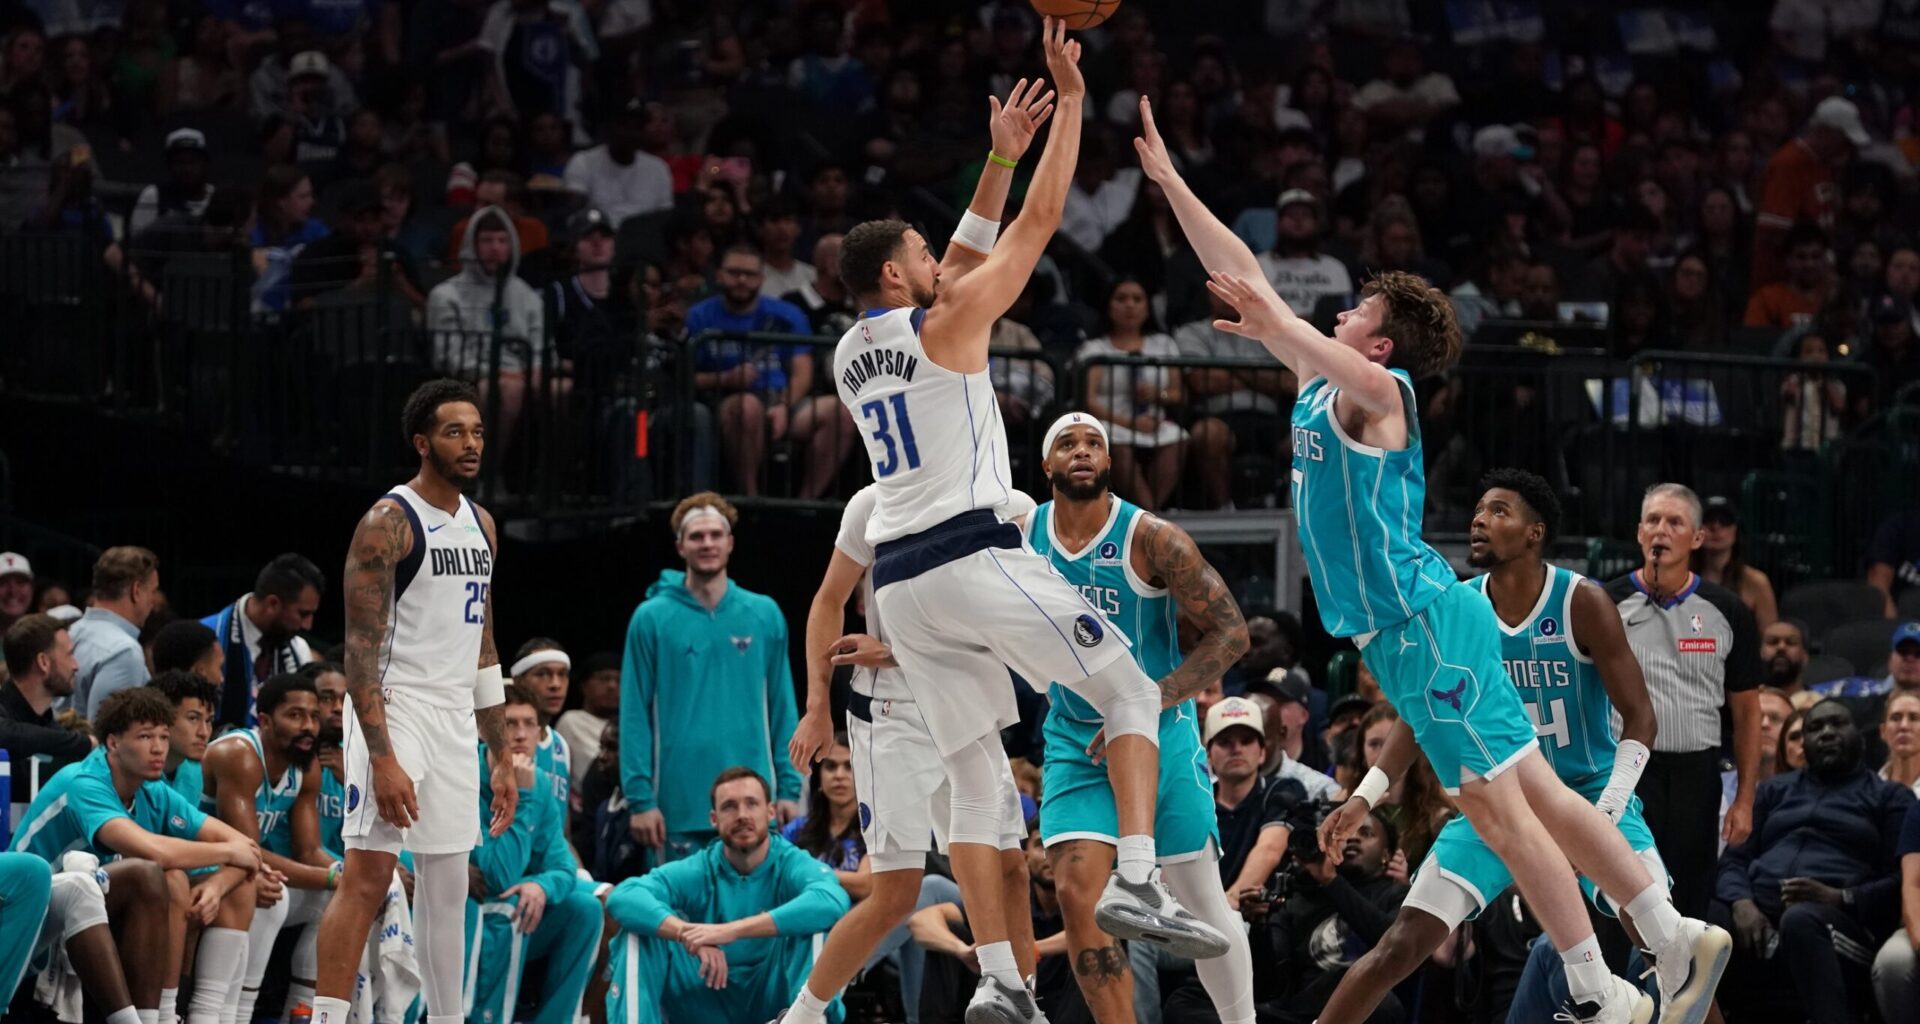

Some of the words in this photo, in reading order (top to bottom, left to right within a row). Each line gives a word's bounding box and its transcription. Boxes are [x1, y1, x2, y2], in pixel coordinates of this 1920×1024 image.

[842, 348, 918, 397] THOMPSON
[861, 391, 921, 478] 31
[429, 547, 491, 577] DALLAS
[1071, 584, 1121, 615] ETS
[1680, 640, 1716, 650] Emirates
